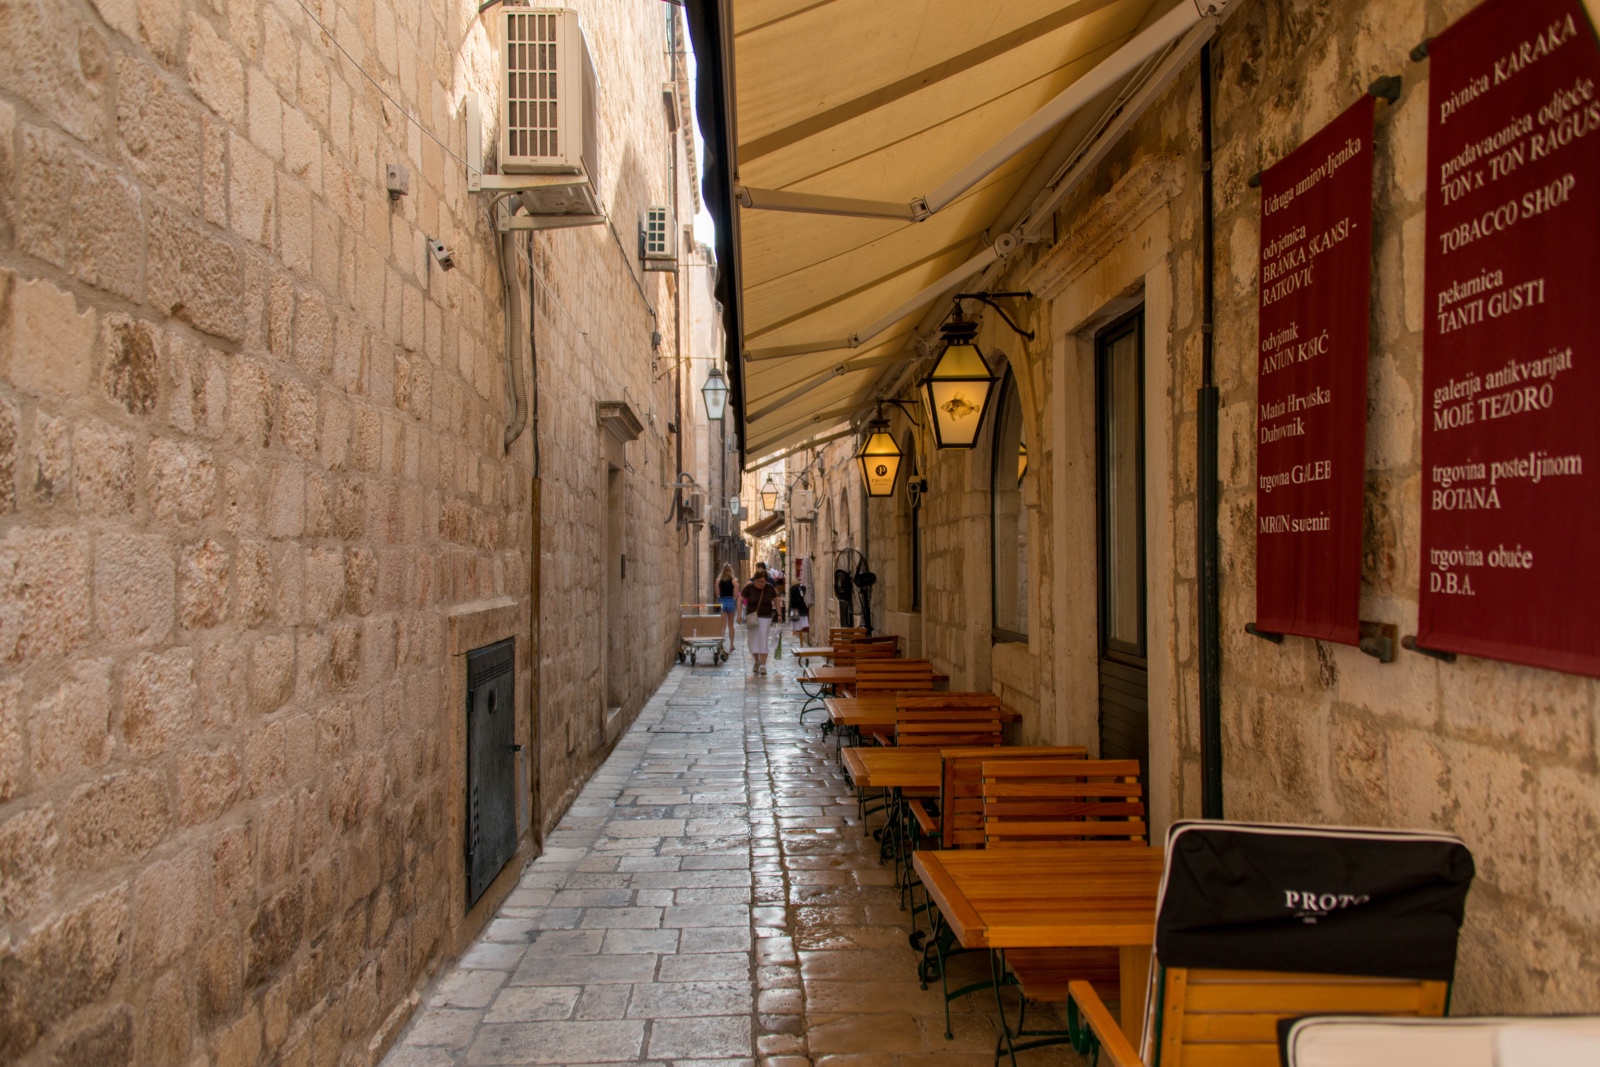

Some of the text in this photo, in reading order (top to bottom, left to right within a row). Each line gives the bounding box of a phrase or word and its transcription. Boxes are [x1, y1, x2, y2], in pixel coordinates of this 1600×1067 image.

[1440, 12, 1578, 124] pivnica KARAKA
[1441, 76, 1594, 185] prodavaonica odjeće
[1264, 137, 1361, 217] Udruga umirovljenika
[1441, 171, 1471, 206] TON
[1488, 142, 1524, 181] TON
[1440, 173, 1575, 254] TOBACCO SHOP
[1263, 225, 1306, 260] odvjetnica
[1263, 246, 1306, 284] BRANKA
[1308, 217, 1349, 260] SKANSI
[1262, 260, 1314, 307] RATKOVIĆ
[1438, 268, 1503, 313] pekarnica
[1438, 278, 1545, 334] TANTI GUSTI
[1262, 321, 1299, 352] odvjetnik
[1262, 346, 1295, 376] ANTUN
[1433, 346, 1573, 409] galerija antikvarijat
[1433, 382, 1554, 432] MOJE TEZORO
[1432, 451, 1582, 487] trgovina posteljinom
[1432, 485, 1501, 510] BOTANA
[1430, 543, 1533, 571] trgovina obuće
[1430, 572, 1475, 596] D.B.A.
